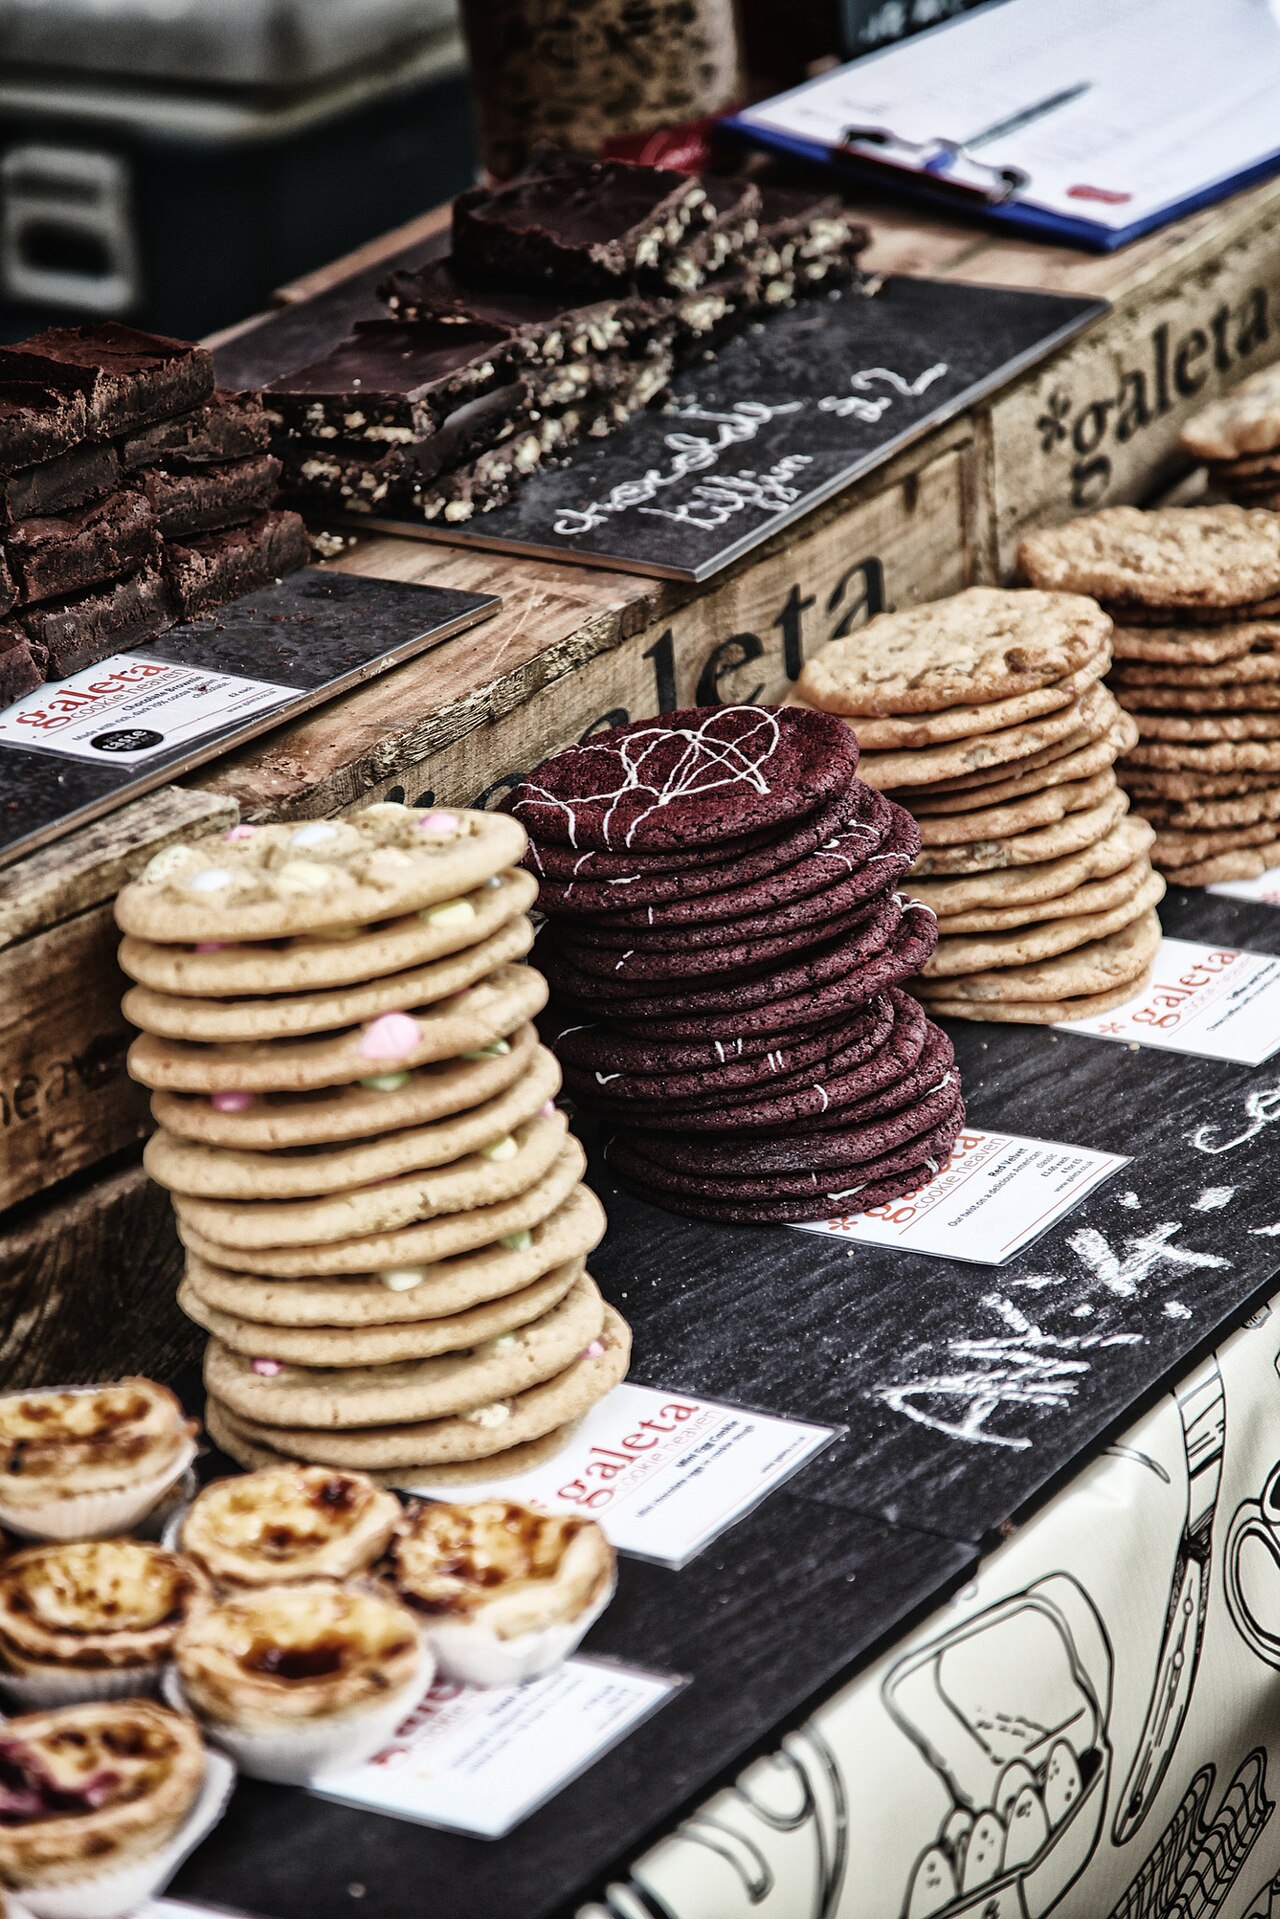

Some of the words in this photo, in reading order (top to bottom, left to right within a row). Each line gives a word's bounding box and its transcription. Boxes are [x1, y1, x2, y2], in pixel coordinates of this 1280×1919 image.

[16, 661, 170, 730] galeta
[71, 694, 129, 719] cookie
[120, 669, 189, 695] heaven
[122, 689, 168, 711] Chocolate
[165, 675, 205, 692] Brownie
[102, 730, 147, 750] taste
[1132, 949, 1242, 1029] galeta
[914, 1173, 961, 1210] cookie
[950, 1137, 1007, 1176] heaven
[947, 1212, 965, 1227] Our
[960, 1204, 980, 1219] twist
[976, 1198, 989, 1207] on
[988, 1171, 1016, 1195] delicious
[1012, 1150, 1043, 1174] American
[987, 1164, 1006, 1178] Red
[1003, 1147, 1028, 1167] Velvet
[1036, 1152, 1058, 1169] classic
[556, 1403, 700, 1509] galeta
[612, 1452, 665, 1495] cookie
[659, 1409, 720, 1452] heaven
[709, 1420, 739, 1443] Cookie
